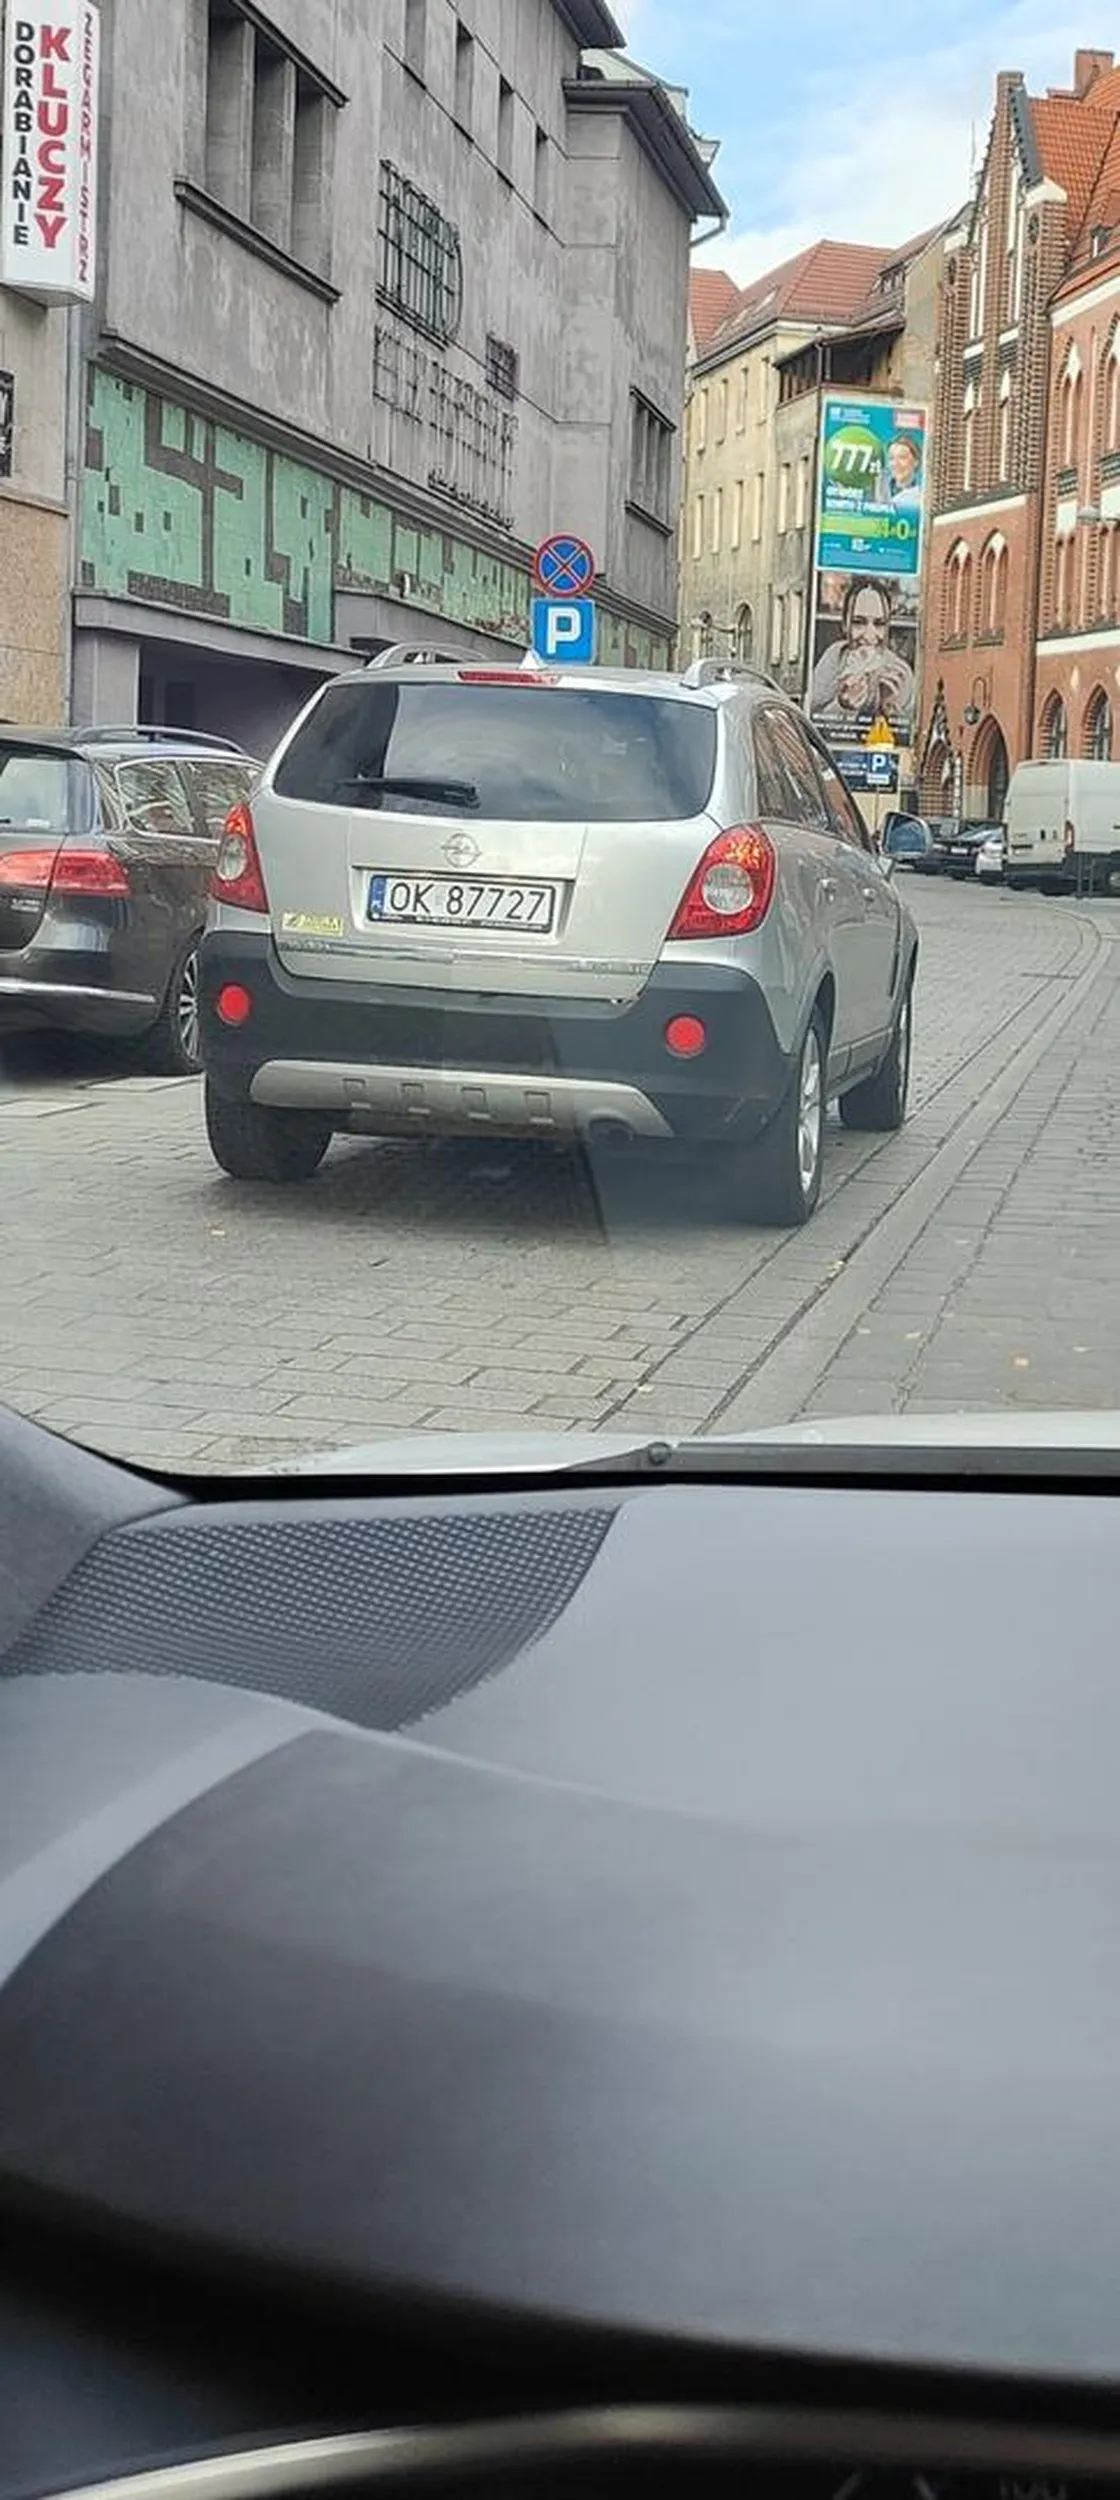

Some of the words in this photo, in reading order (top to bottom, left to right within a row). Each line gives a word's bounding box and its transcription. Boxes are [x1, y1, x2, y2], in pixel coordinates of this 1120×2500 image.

[13, 21, 35, 246] DORABIANIE
[34, 24, 72, 250] KLUCZY
[547, 606, 581, 655] P
[872, 754, 886, 772] P
[390, 882, 434, 914] OK
[446, 885, 546, 922] 87727
